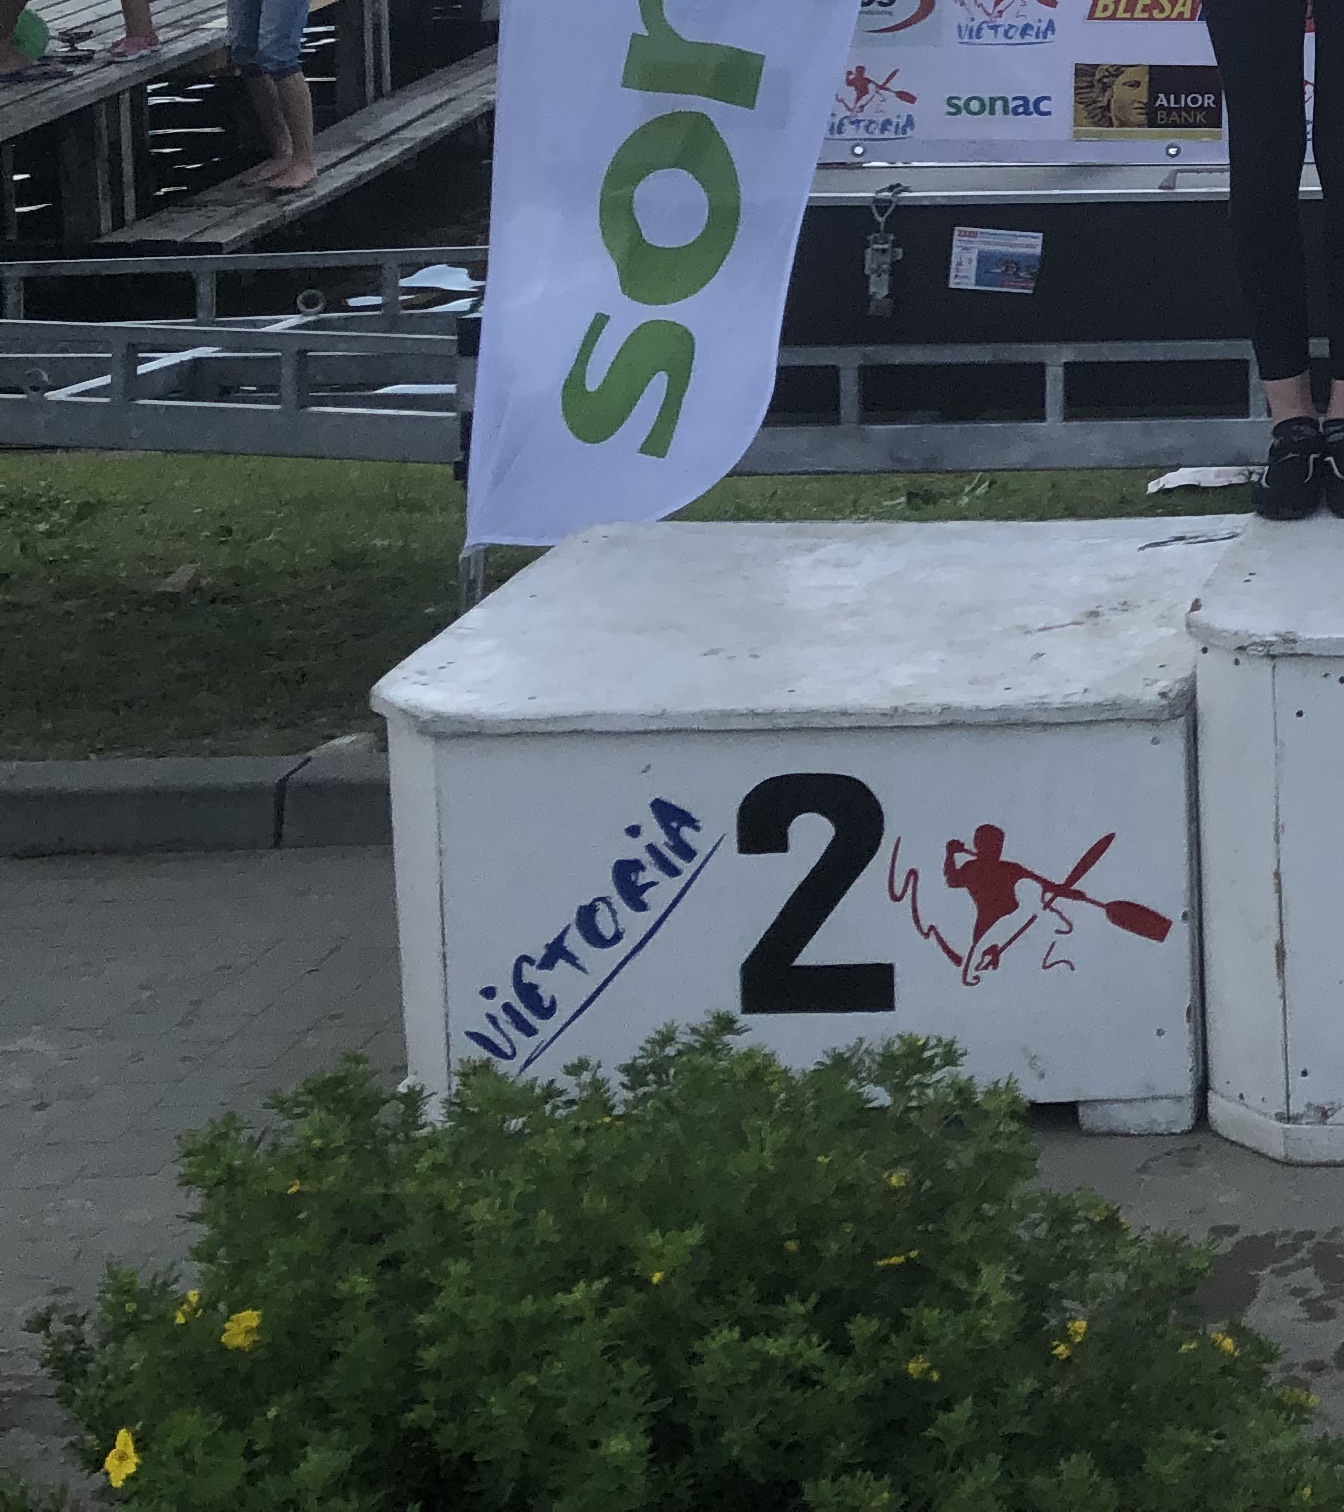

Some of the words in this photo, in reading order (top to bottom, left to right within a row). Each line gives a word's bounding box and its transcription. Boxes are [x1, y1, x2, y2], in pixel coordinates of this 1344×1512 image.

[946, 93, 1053, 117] sonac
[1154, 92, 1217, 109] ALIOR
[1156, 110, 1209, 125] BANK
[736, 772, 896, 1016] 2
